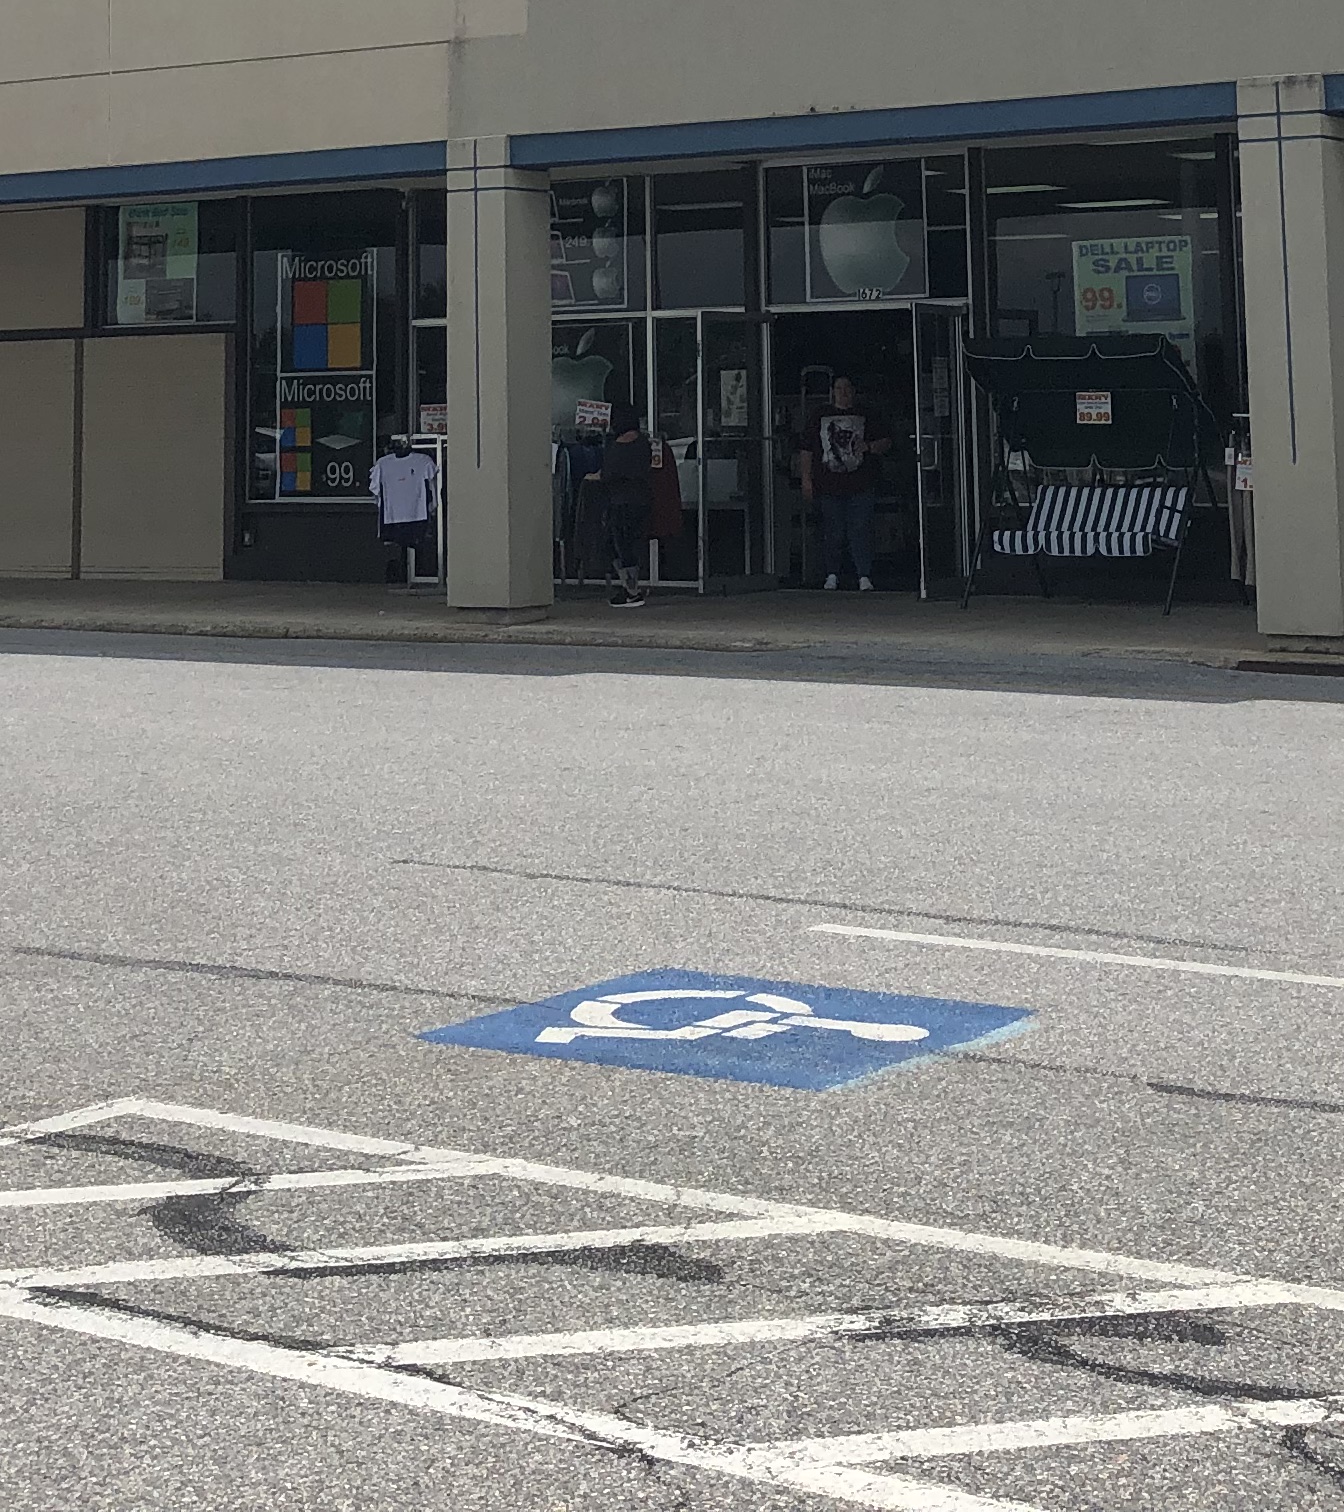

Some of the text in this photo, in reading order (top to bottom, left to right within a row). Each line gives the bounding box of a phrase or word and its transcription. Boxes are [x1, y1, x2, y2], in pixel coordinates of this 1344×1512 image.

[1079, 240, 1189, 257] DELL LAPTOP
[281, 252, 373, 280] Microsoft
[1092, 254, 1176, 274] SALE
[281, 377, 372, 403] Microsoft
